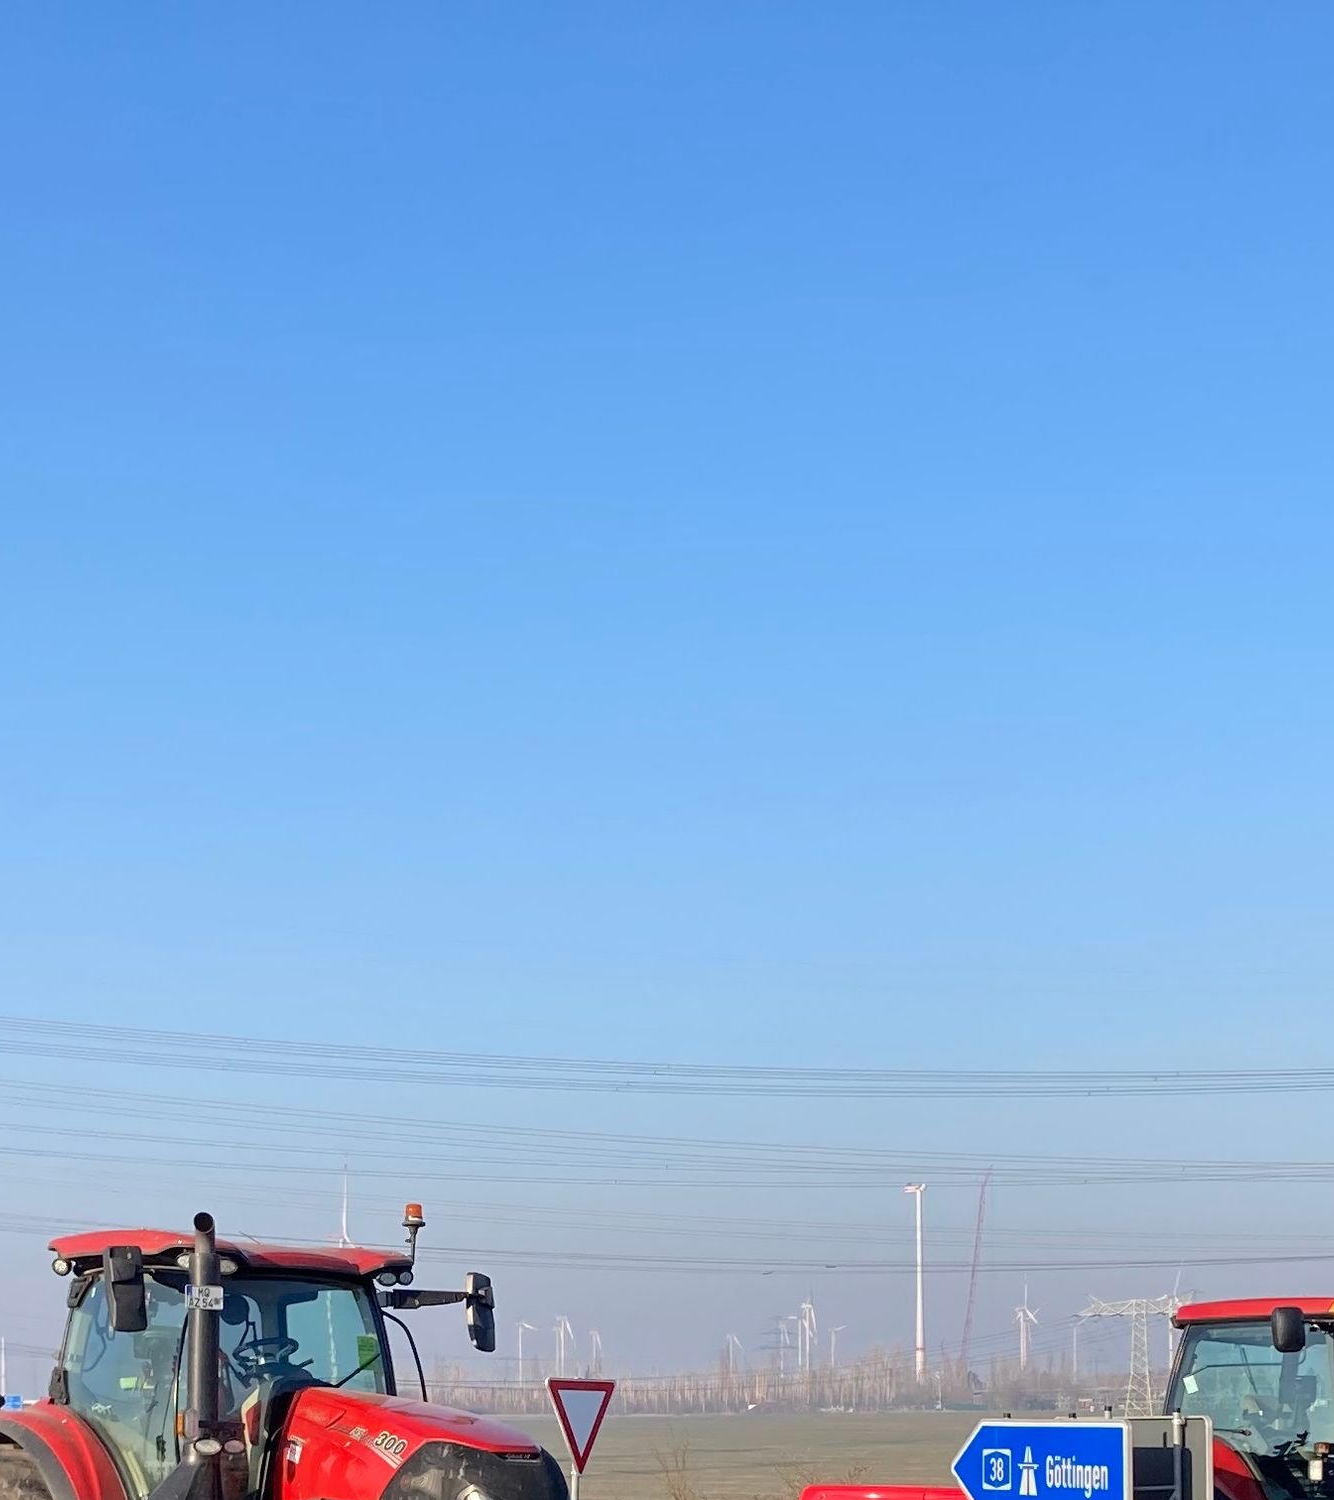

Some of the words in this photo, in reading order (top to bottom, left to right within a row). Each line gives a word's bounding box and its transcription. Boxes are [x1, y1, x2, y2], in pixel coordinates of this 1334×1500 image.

[374, 1432, 407, 1455] 300
[990, 1457, 1004, 1481] 38
[1046, 1455, 1109, 1499] Göttingen
